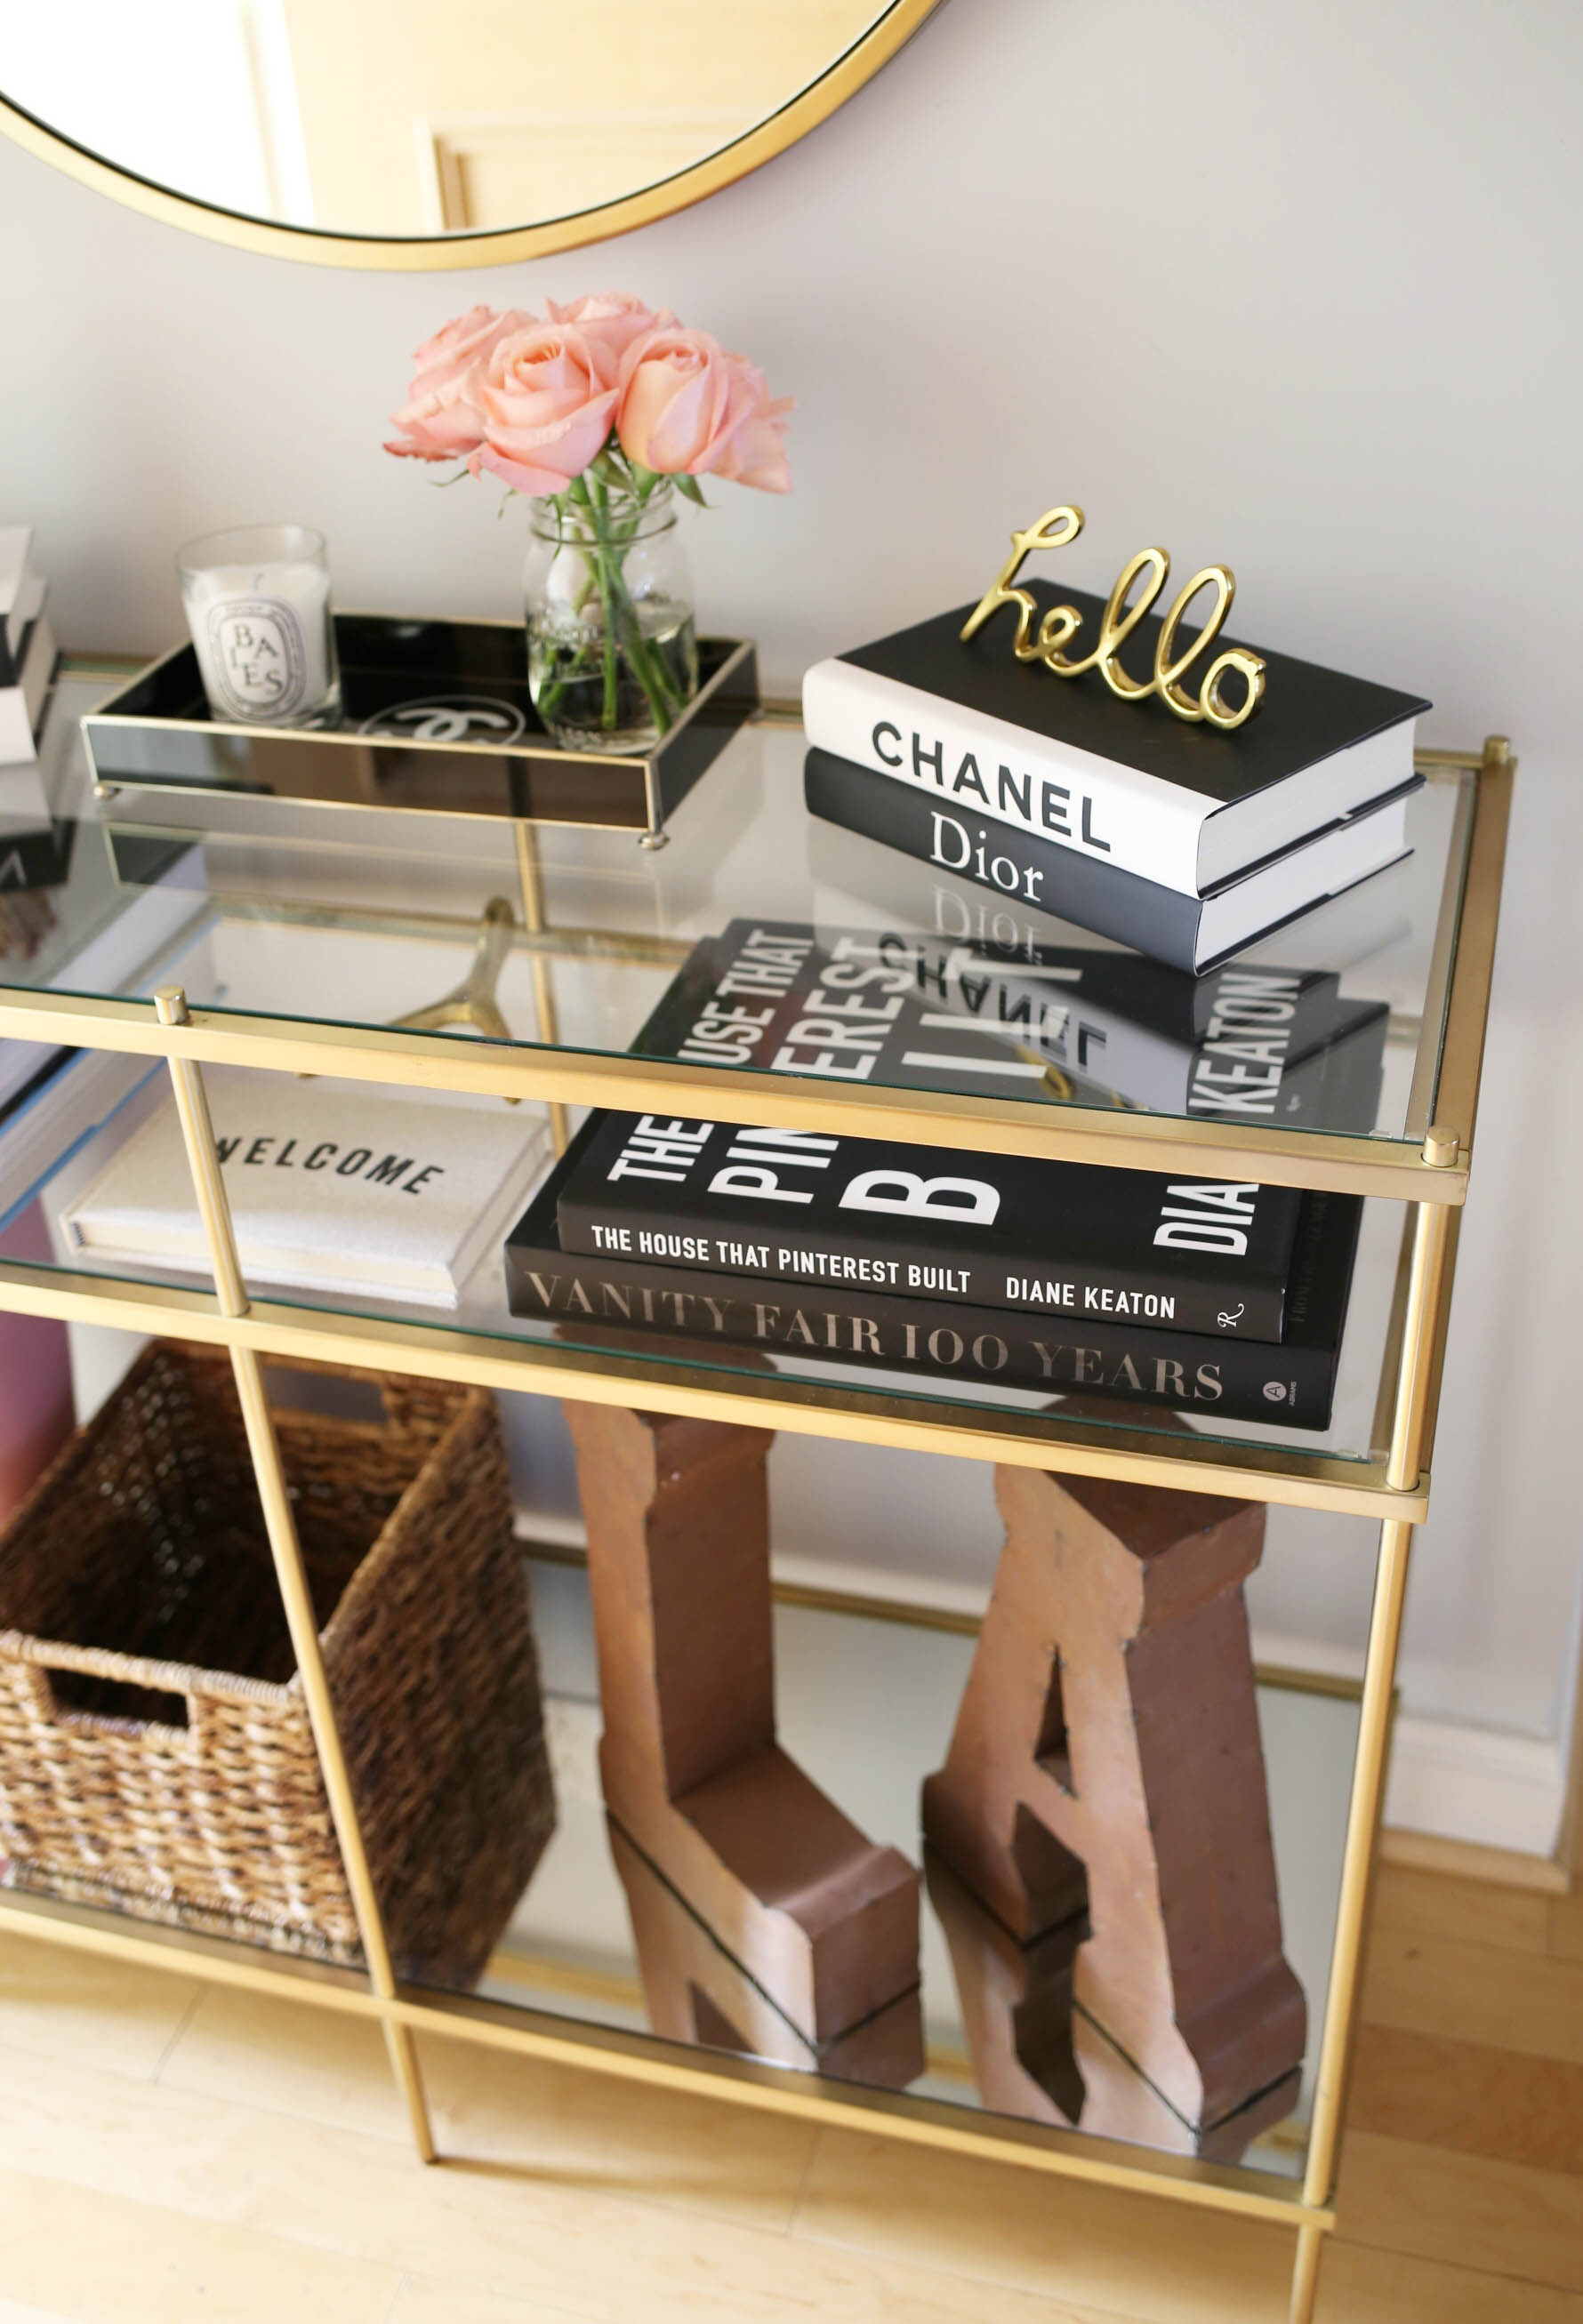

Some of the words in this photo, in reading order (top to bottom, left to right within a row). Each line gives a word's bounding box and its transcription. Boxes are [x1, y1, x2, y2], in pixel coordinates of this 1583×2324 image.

[960, 505, 1267, 730] hello
[872, 721, 1112, 853] CHANEL
[929, 812, 1044, 902] Dior
[716, 929, 814, 998] THAT
[677, 1001, 776, 1065] USE
[1188, 973, 1301, 1113] KEATON
[214, 1137, 444, 1194] WELCOME
[607, 1115, 714, 1182] THE
[1153, 1183, 1259, 1255] DIA
[591, 1225, 631, 1252] THE
[639, 1231, 710, 1262] HOUSE
[716, 1240, 769, 1269] THAT
[778, 1249, 899, 1285] PINTEREST
[908, 1265, 971, 1294] BUILT
[1006, 1277, 1075, 1307] DIANE
[1084, 1287, 1176, 1319] KEATON
[526, 1271, 735, 1332] VANITY
[751, 1303, 886, 1357] FAIR
[1032, 1340, 1224, 1403] YEARS
